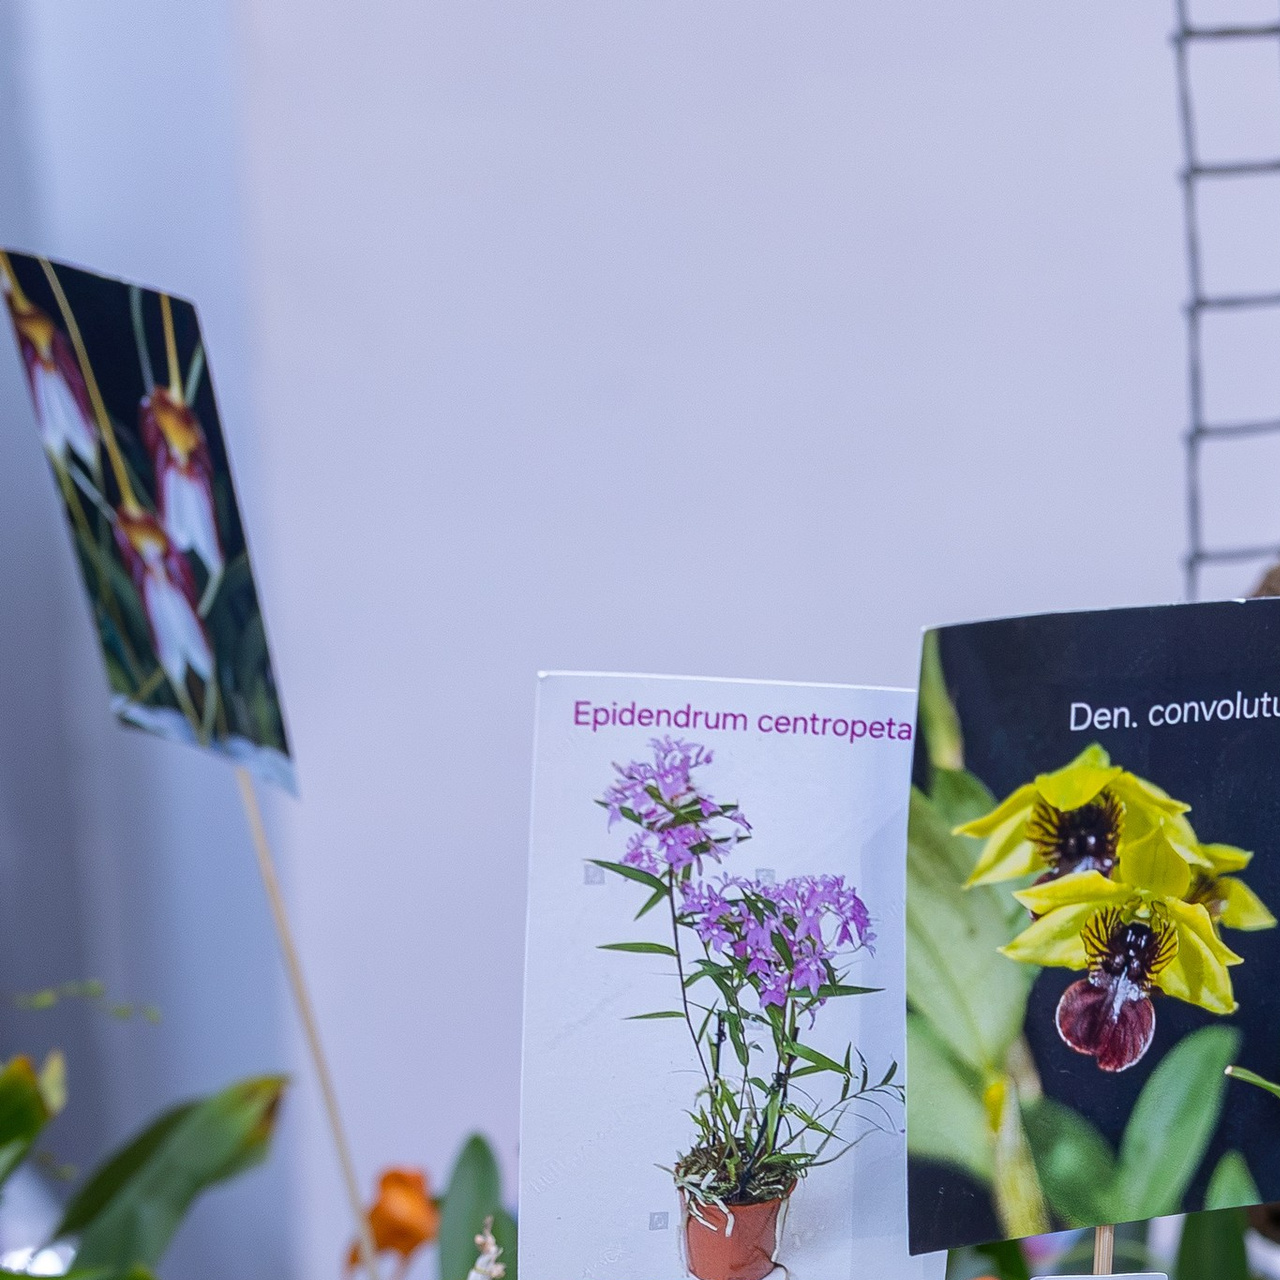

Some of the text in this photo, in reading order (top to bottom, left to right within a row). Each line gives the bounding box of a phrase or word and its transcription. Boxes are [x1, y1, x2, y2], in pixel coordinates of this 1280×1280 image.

[573, 700, 913, 743] Epidendrum centropeta
[1070, 702, 1138, 731] Den.
